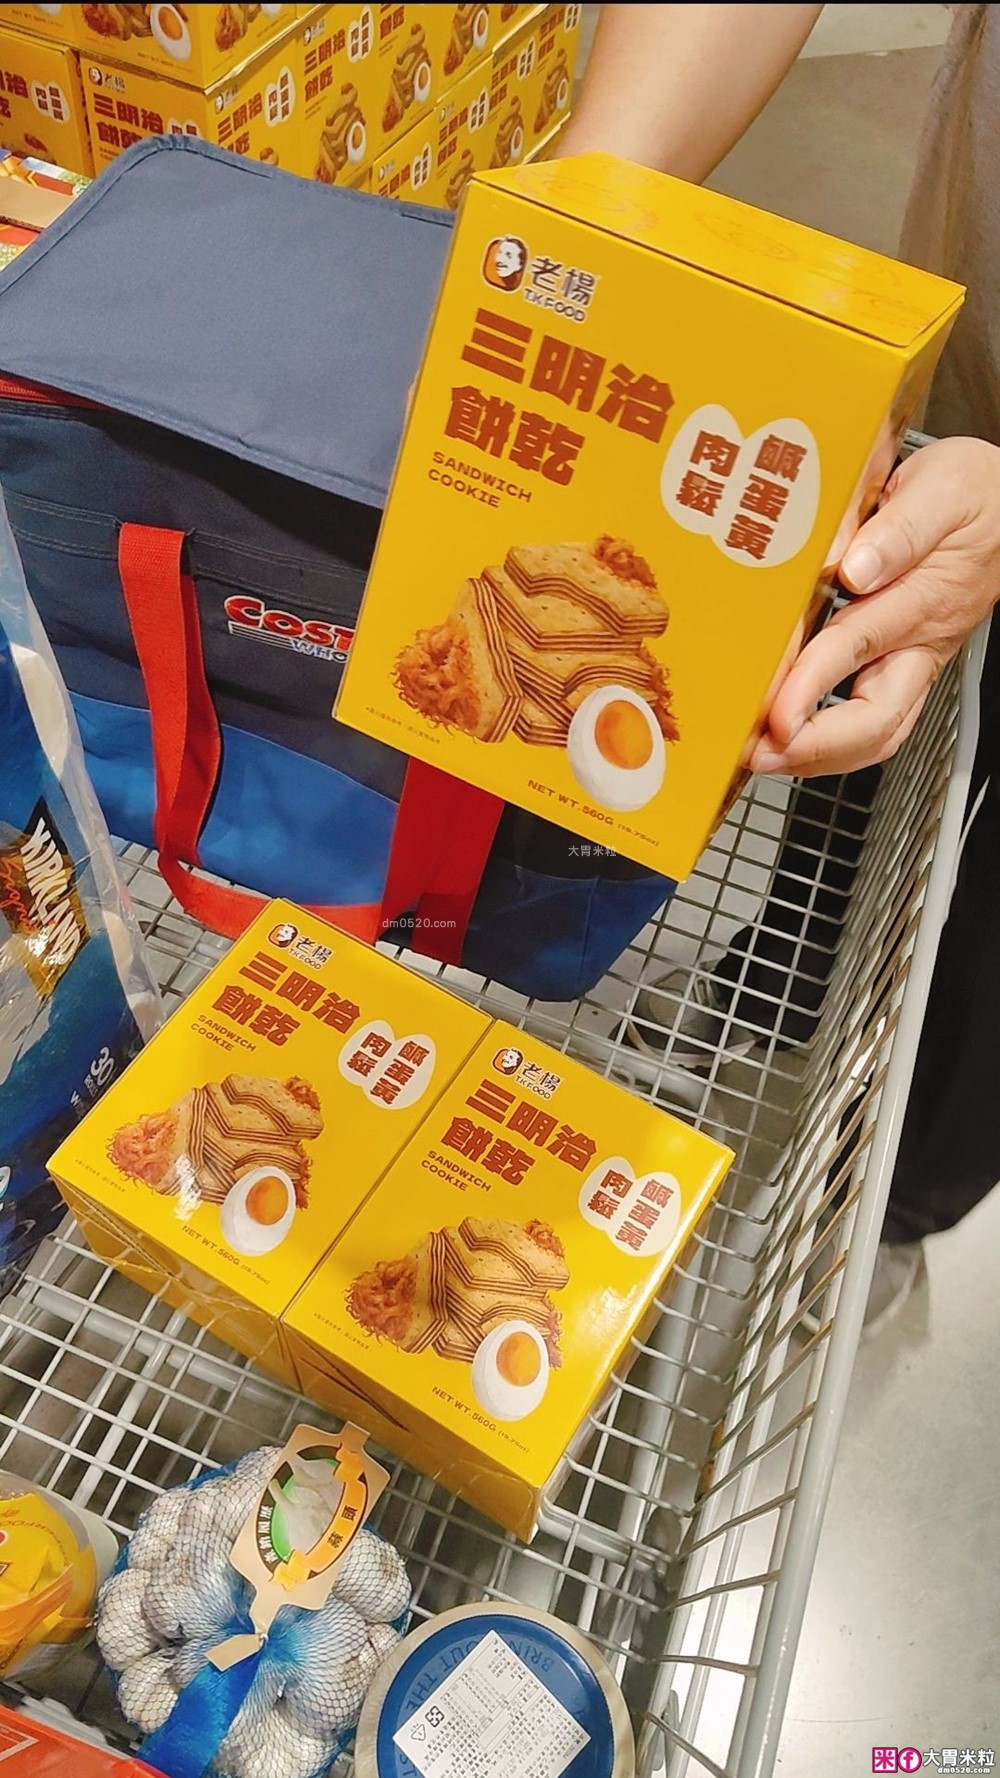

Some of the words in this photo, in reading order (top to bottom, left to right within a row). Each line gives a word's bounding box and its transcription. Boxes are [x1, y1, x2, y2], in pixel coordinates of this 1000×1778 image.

[531, 258, 595, 306] 老楊
[461, 307, 675, 444] 三明治
[444, 385, 585, 486] 餅乾
[428, 468, 501, 508] COOKIE
[432, 451, 532, 503] SANDWICH
[676, 430, 741, 517] 肉鬆
[724, 434, 808, 560] 鹹蛋黃
[224, 595, 356, 652] COST
[527, 779, 556, 797] NET
[20, 817, 80, 965] KIRKLAND
[295, 936, 333, 963] 老楊
[212, 984, 301, 1046] 餅乾
[239, 951, 361, 1034] 三明治
[190, 1023, 236, 1052] COOKIE
[198, 1014, 257, 1052] SANDWICH
[347, 1031, 392, 1077] 肉鬆
[90, 1046, 115, 1086] 30
[370, 1040, 430, 1104] 鹹蛋黃
[522, 1062, 561, 1092] 老楊
[465, 1078, 598, 1173] 三明治
[427, 1150, 492, 1192] SANDWICH
[440, 1116, 536, 1186] 餅乾
[421, 1160, 469, 1192] COOKIE
[587, 1169, 634, 1220] 肉鬆
[181, 1225, 203, 1240] NET
[615, 1179, 675, 1251] 鹹蛋黃
[431, 1386, 455, 1403] NET
[327, 1504, 358, 1549] 蒜頭
